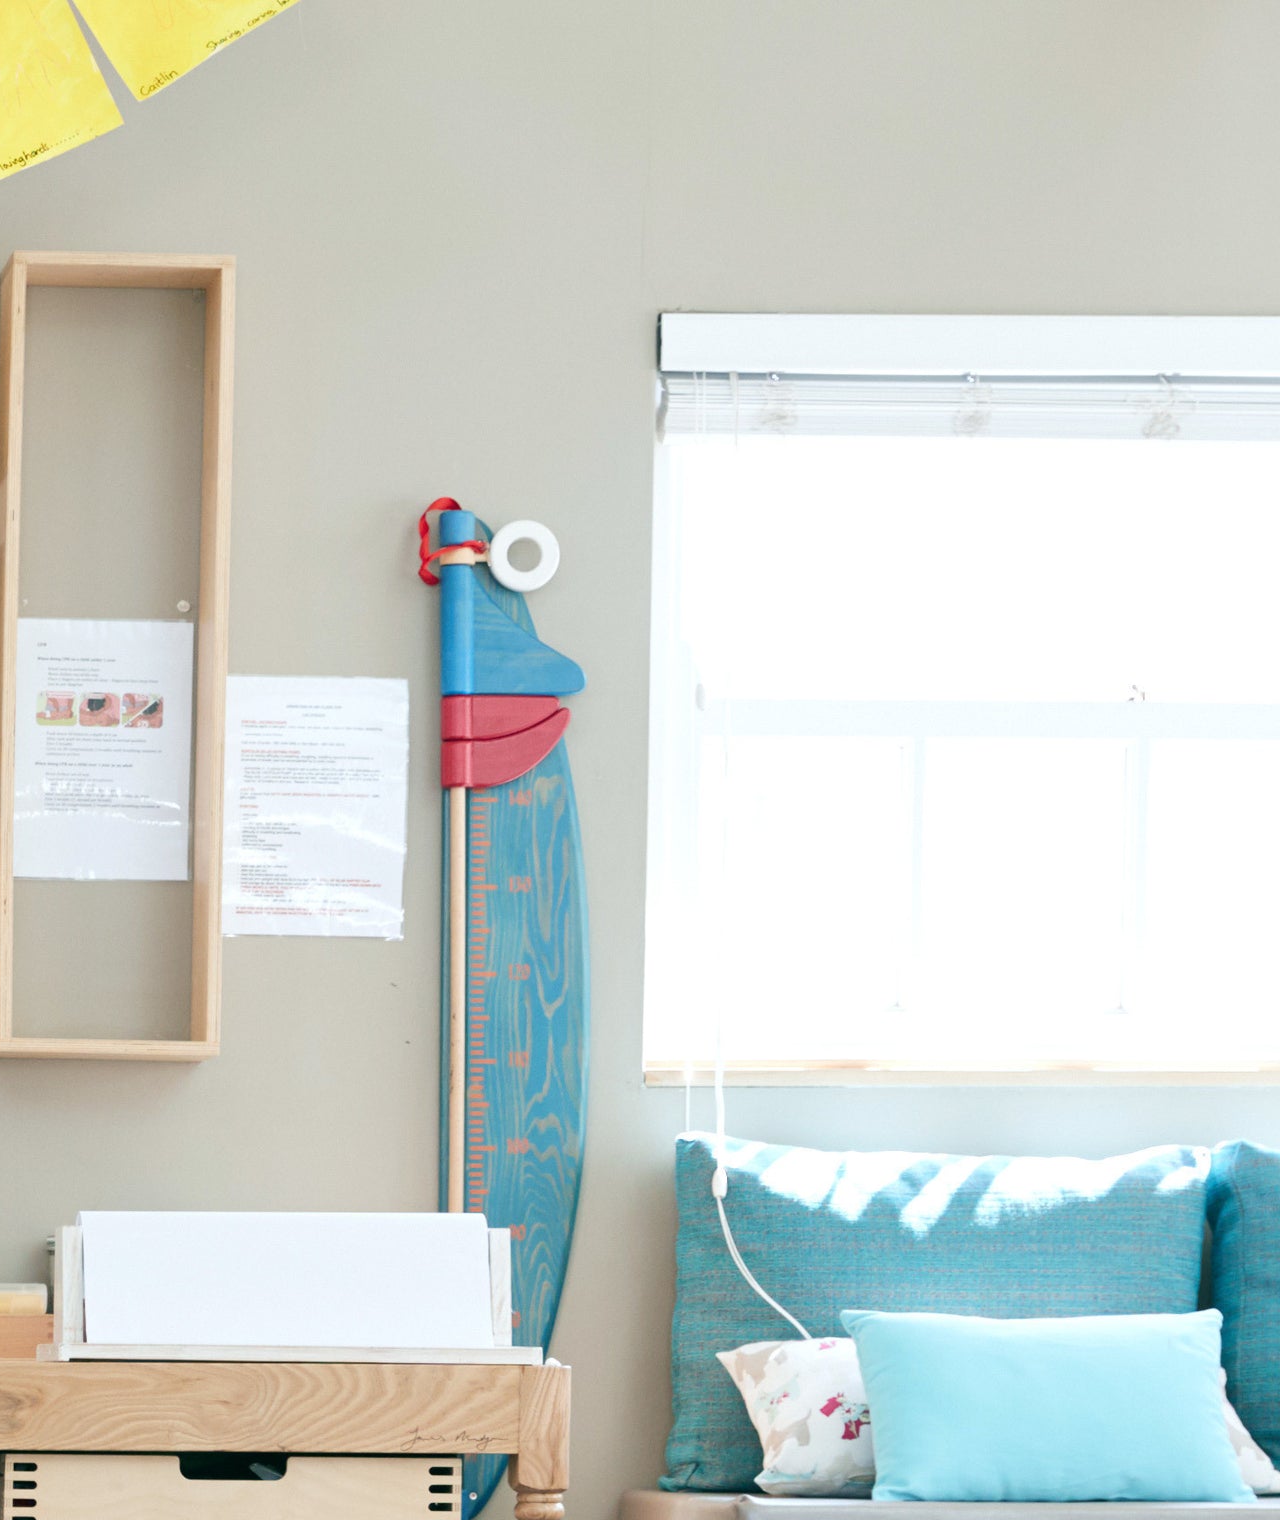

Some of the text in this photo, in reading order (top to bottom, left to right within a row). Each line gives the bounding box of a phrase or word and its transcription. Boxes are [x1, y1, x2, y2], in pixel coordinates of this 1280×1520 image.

[140, 69, 179, 97] Caitlin
[509, 789, 532, 806] 140
[509, 876, 532, 893] 130
[508, 963, 531, 980] 120
[508, 1051, 529, 1068] 110
[507, 1138, 530, 1154] 100
